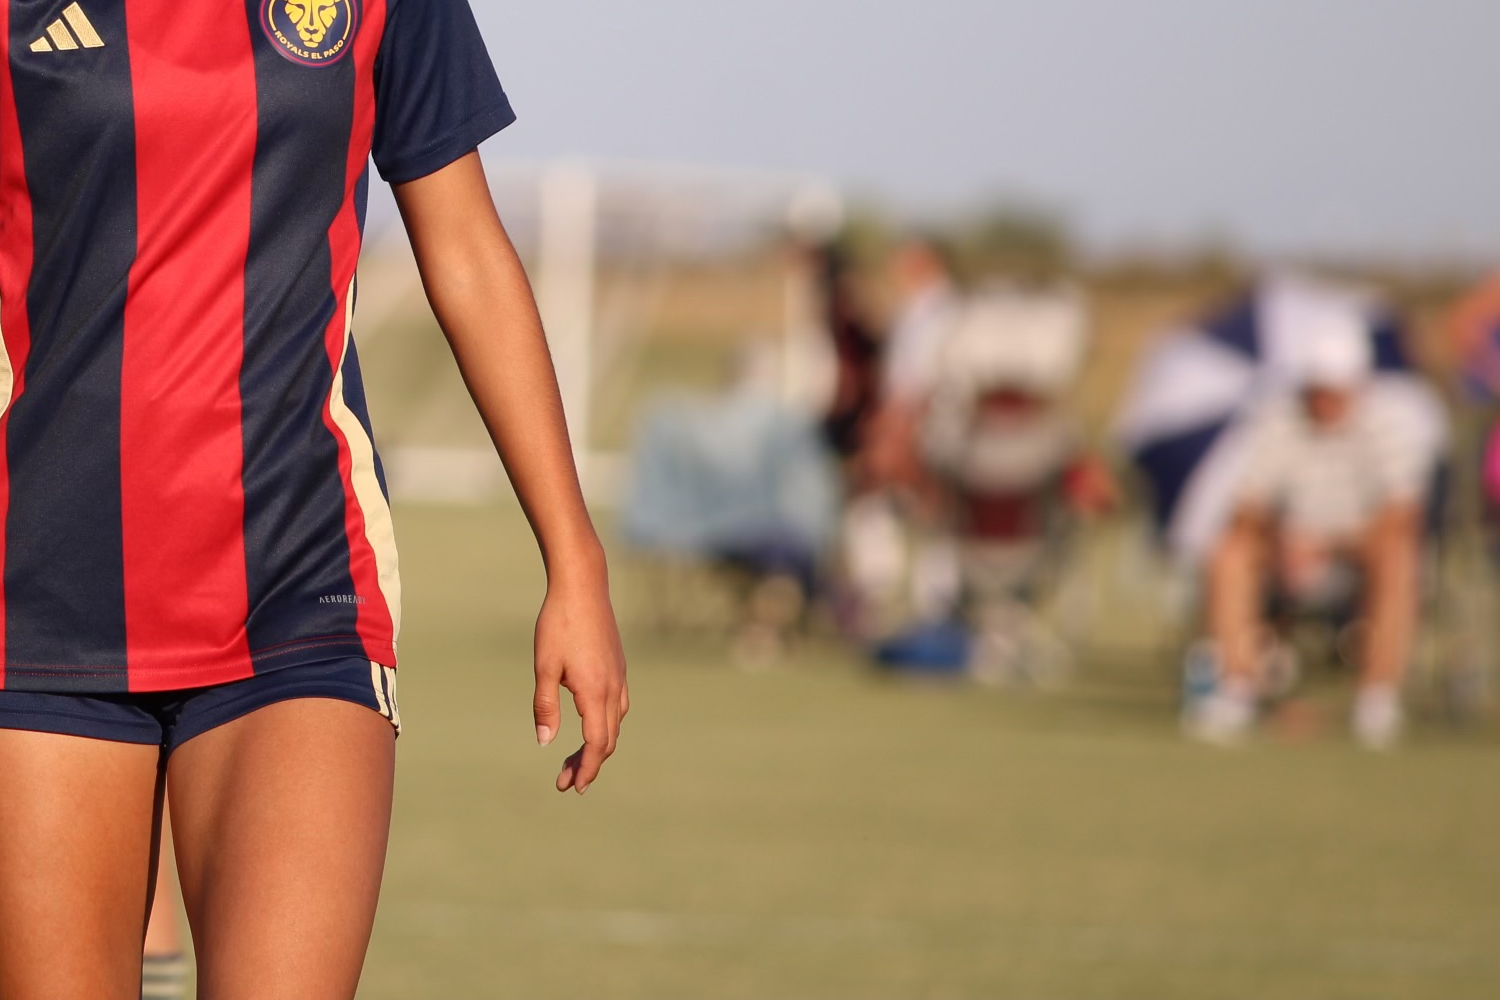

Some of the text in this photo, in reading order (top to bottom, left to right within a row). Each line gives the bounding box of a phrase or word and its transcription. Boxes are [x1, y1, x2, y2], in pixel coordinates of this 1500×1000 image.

[275, 31, 309, 58] ROYALS
[323, 40, 343, 58] PASO
[319, 594, 366, 605] AEROREADY
